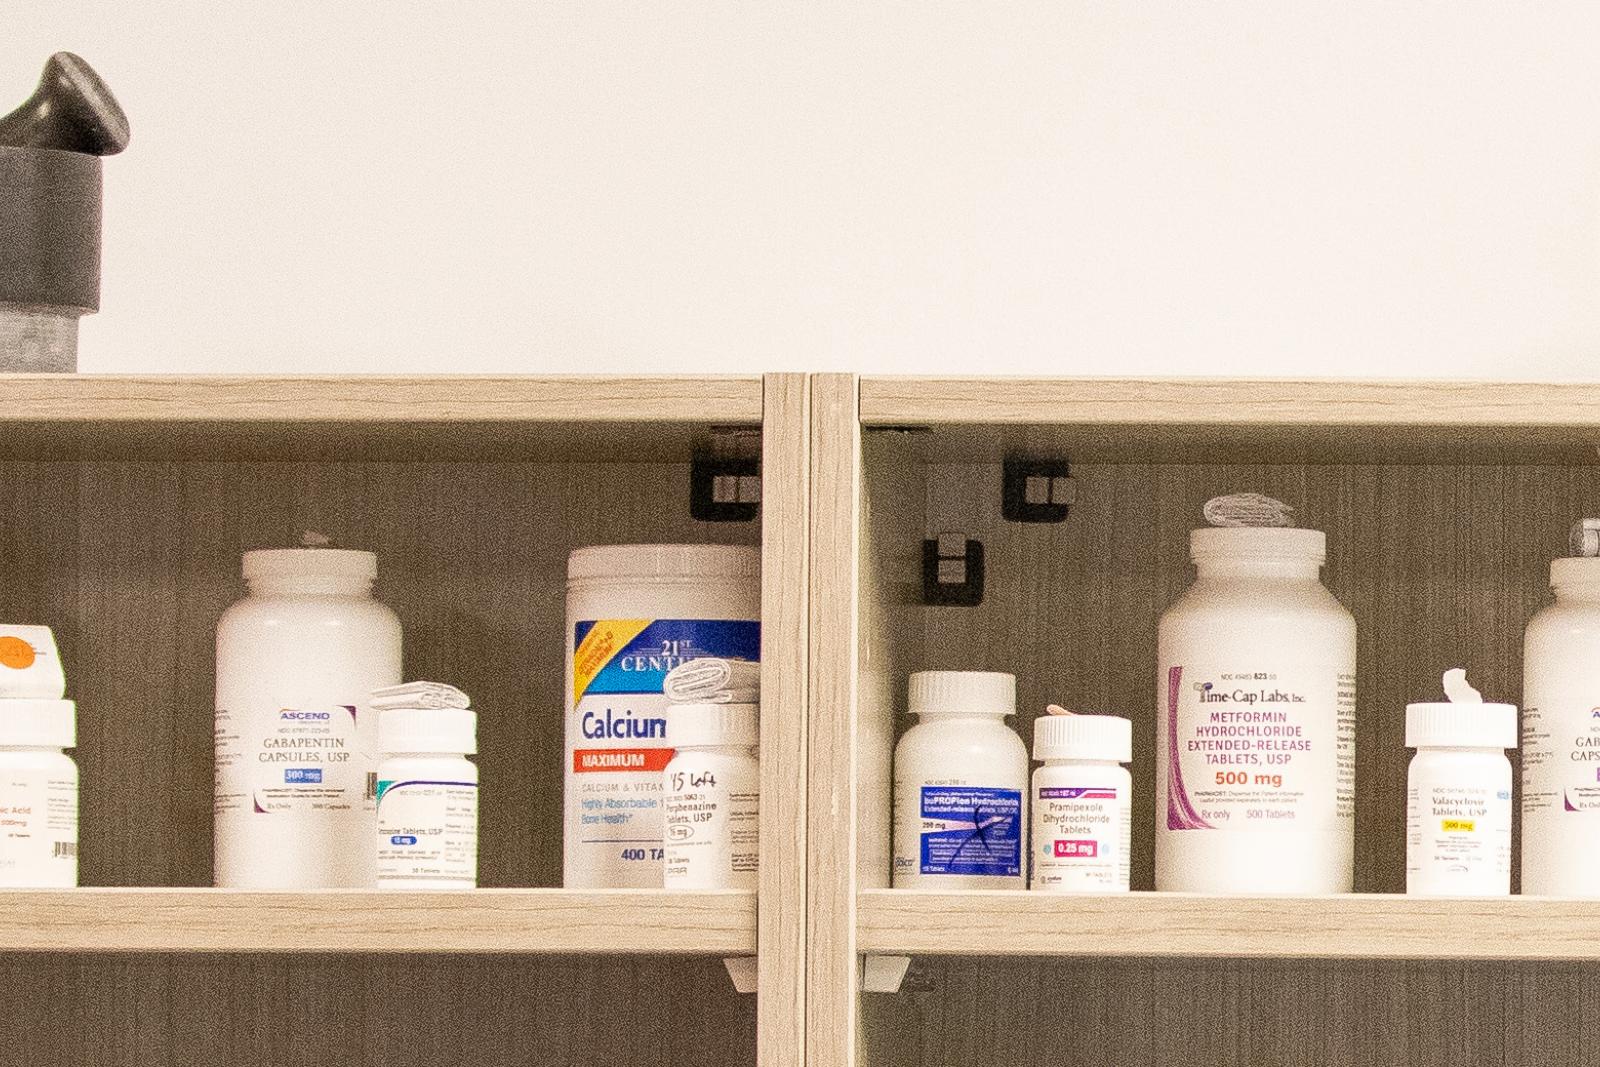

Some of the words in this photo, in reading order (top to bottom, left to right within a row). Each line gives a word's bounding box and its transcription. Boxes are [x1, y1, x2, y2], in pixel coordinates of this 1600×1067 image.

[1253, 672, 1267, 680] 823
[1195, 683, 1257, 706] Time-Cap
[280, 712, 330, 720] ASCEND
[1210, 712, 1287, 723] METFORMIN
[1196, 726, 1302, 737] HYDROCHLORIDE
[263, 738, 345, 748] GABAPENTIN
[1187, 740, 1312, 751] EXTENDED-RELEASE
[258, 752, 324, 764] CAPSULES,
[328, 752, 350, 763] USP
[582, 754, 645, 767] MAXIMUM
[1205, 754, 1262, 767] TABLETS,
[1267, 754, 1292, 764] USP
[286, 770, 304, 779] 300
[305, 772, 321, 782] mg
[1215, 771, 1248, 785] 500
[1254, 773, 1282, 788] mg
[582, 783, 619, 792] CALCIUM
[1049, 802, 1103, 813] Pramipexole
[693, 812, 713, 823] USP
[1042, 814, 1110, 825] Dihydrochloride
[1213, 809, 1231, 821] only
[1266, 809, 1295, 819] Tablets
[1059, 825, 1092, 834] Tablets
[621, 848, 645, 860] 400
[1058, 843, 1077, 853] 0.25
[1078, 844, 1093, 856] mg
